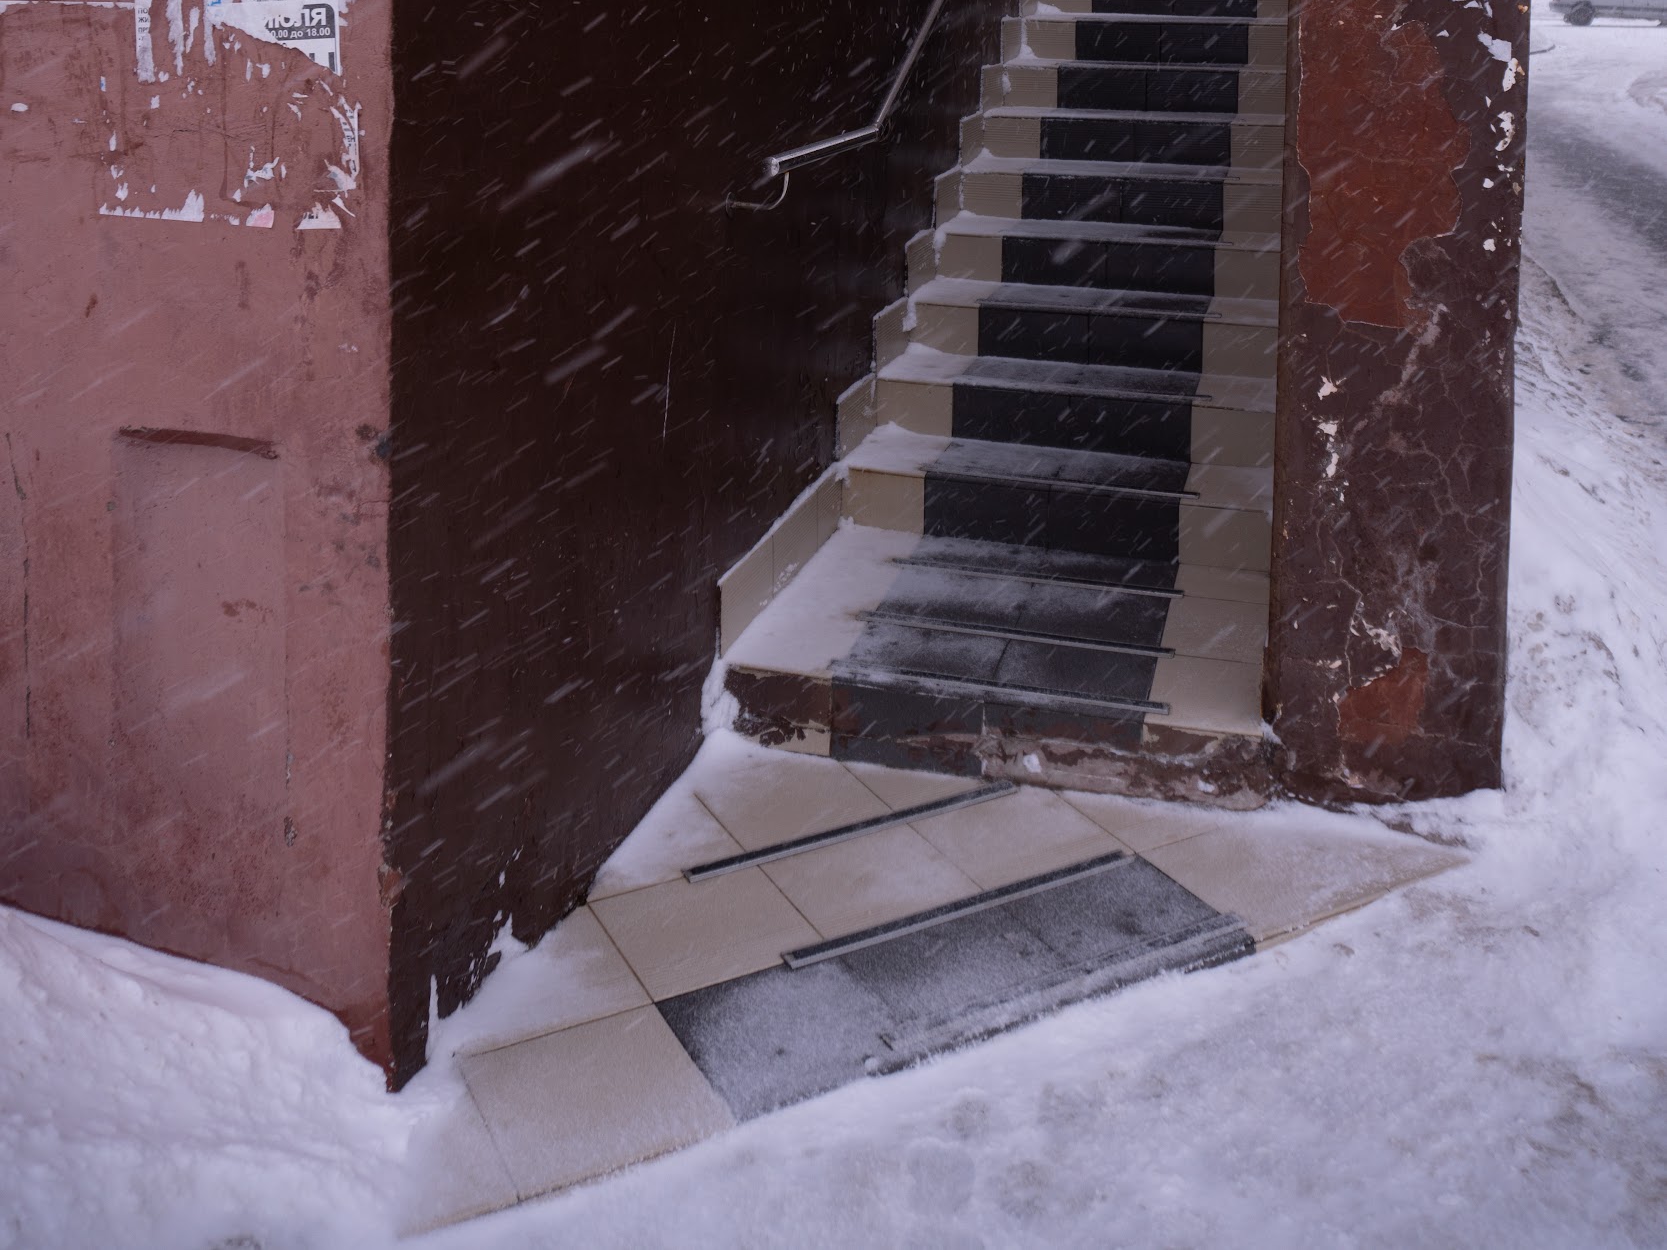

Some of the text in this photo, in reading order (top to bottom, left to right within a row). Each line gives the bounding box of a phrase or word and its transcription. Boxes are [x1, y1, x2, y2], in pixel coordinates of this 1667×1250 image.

[269, 27, 331, 39] 0.00 до 18.00
